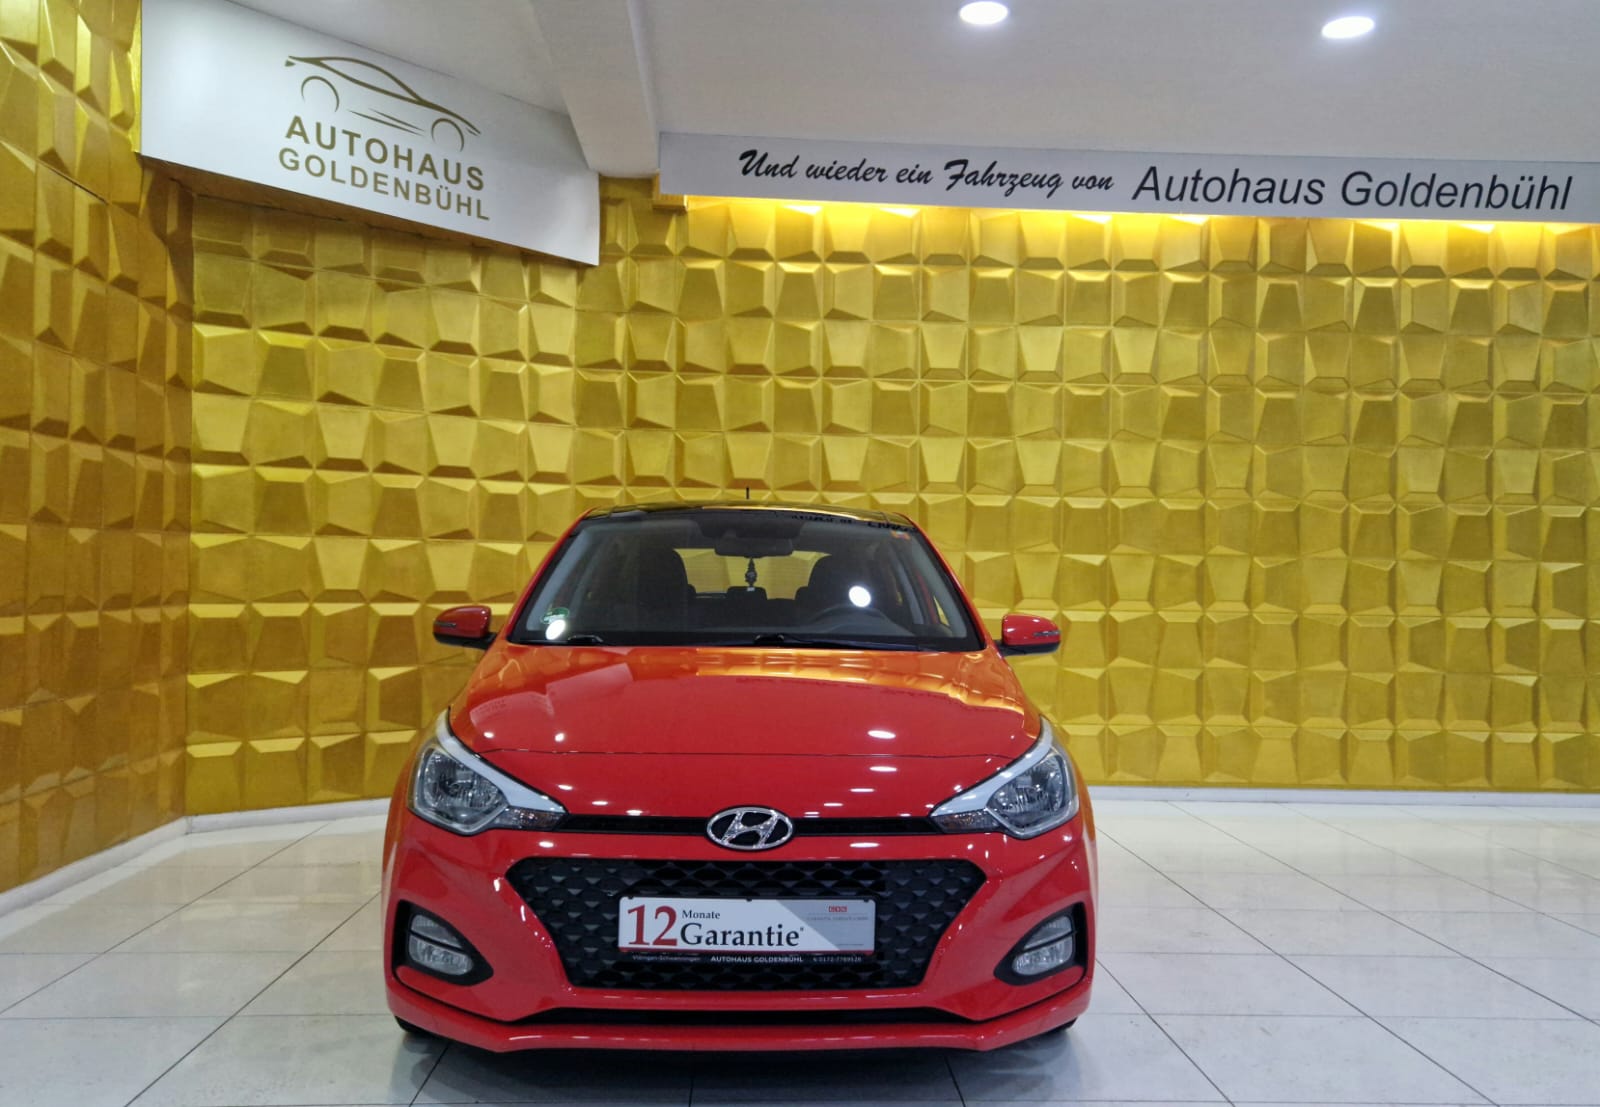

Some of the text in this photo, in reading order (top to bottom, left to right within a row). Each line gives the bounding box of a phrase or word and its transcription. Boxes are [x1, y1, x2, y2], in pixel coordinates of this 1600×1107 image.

[285, 115, 485, 191] AUTOHAUS
[278, 147, 490, 221] GOLDENBÜHL
[739, 149, 1573, 210] Und wieder ein Fahrzeug von Autohaus Goldenbühl
[627, 904, 678, 946] 12
[682, 909, 721, 920] Monate
[710, 955, 752, 963] AUTOHAUS
